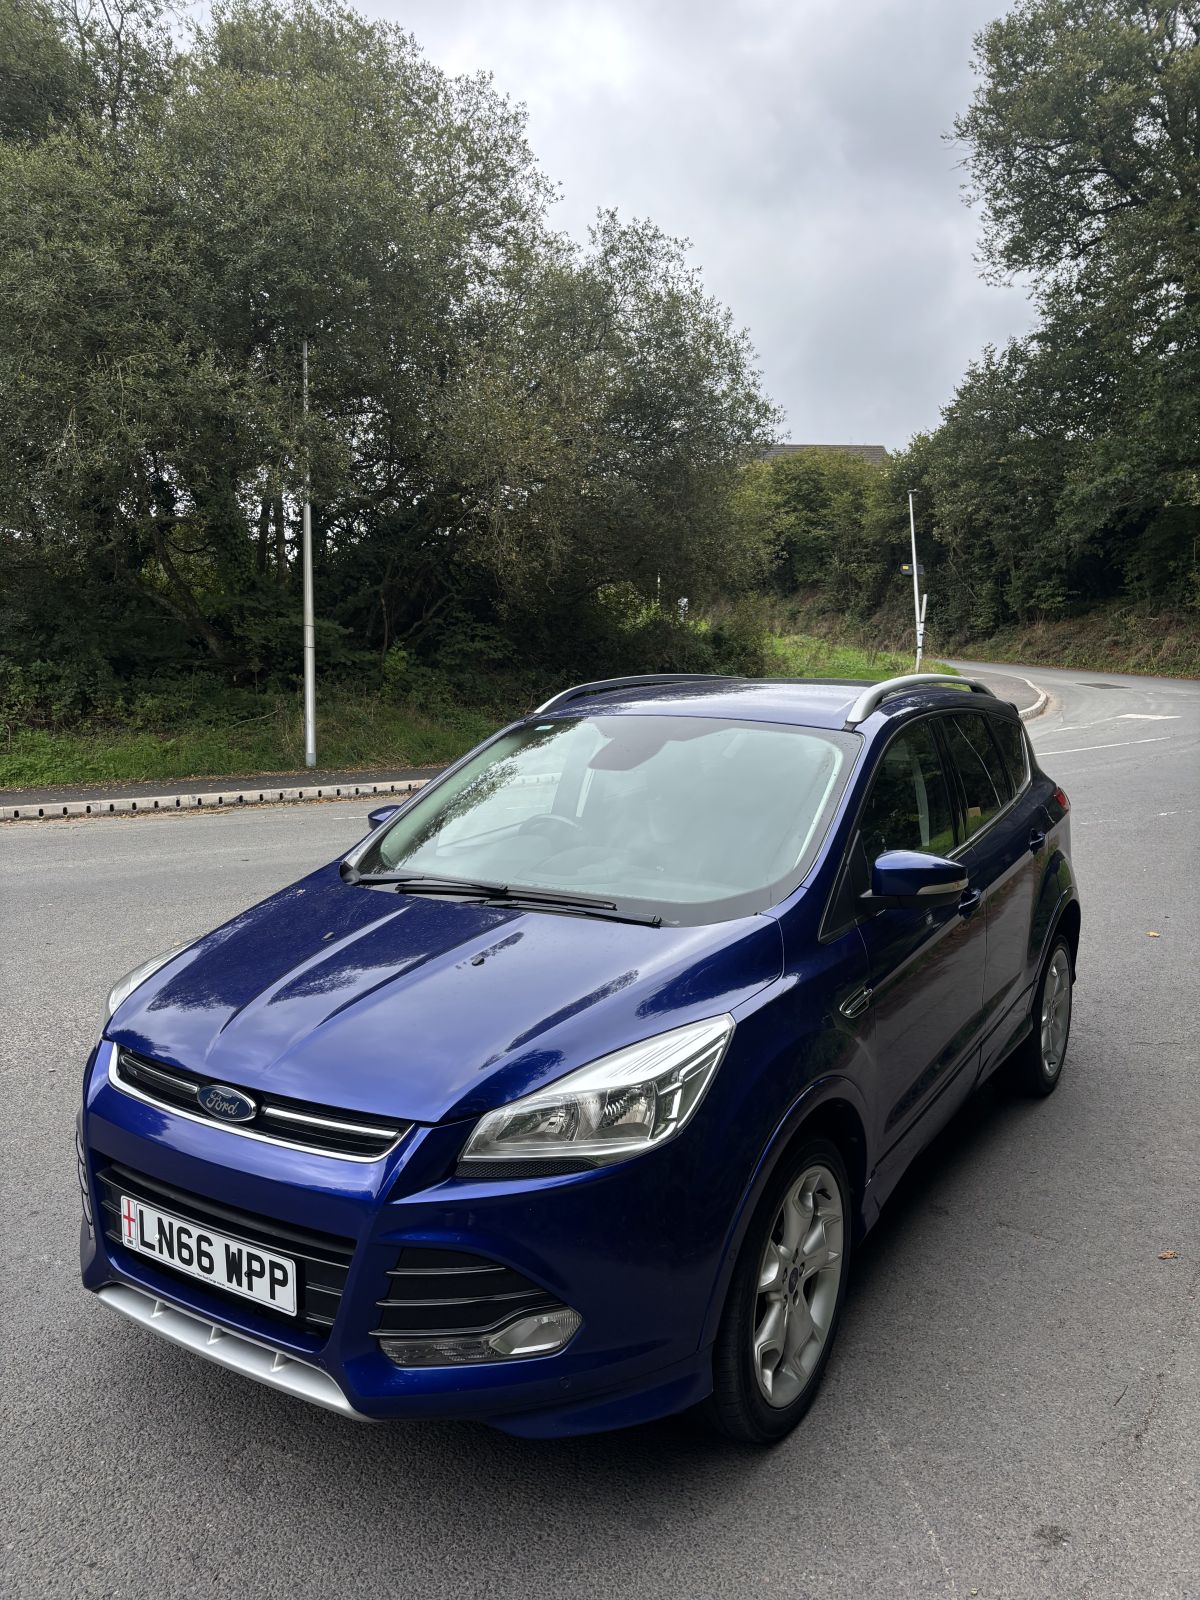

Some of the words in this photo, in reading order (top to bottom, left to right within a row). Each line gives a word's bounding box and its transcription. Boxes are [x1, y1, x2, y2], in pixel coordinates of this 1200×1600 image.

[206, 1089, 240, 1115] Ford
[138, 1209, 215, 1275] LN66
[224, 1243, 289, 1301] WPP
